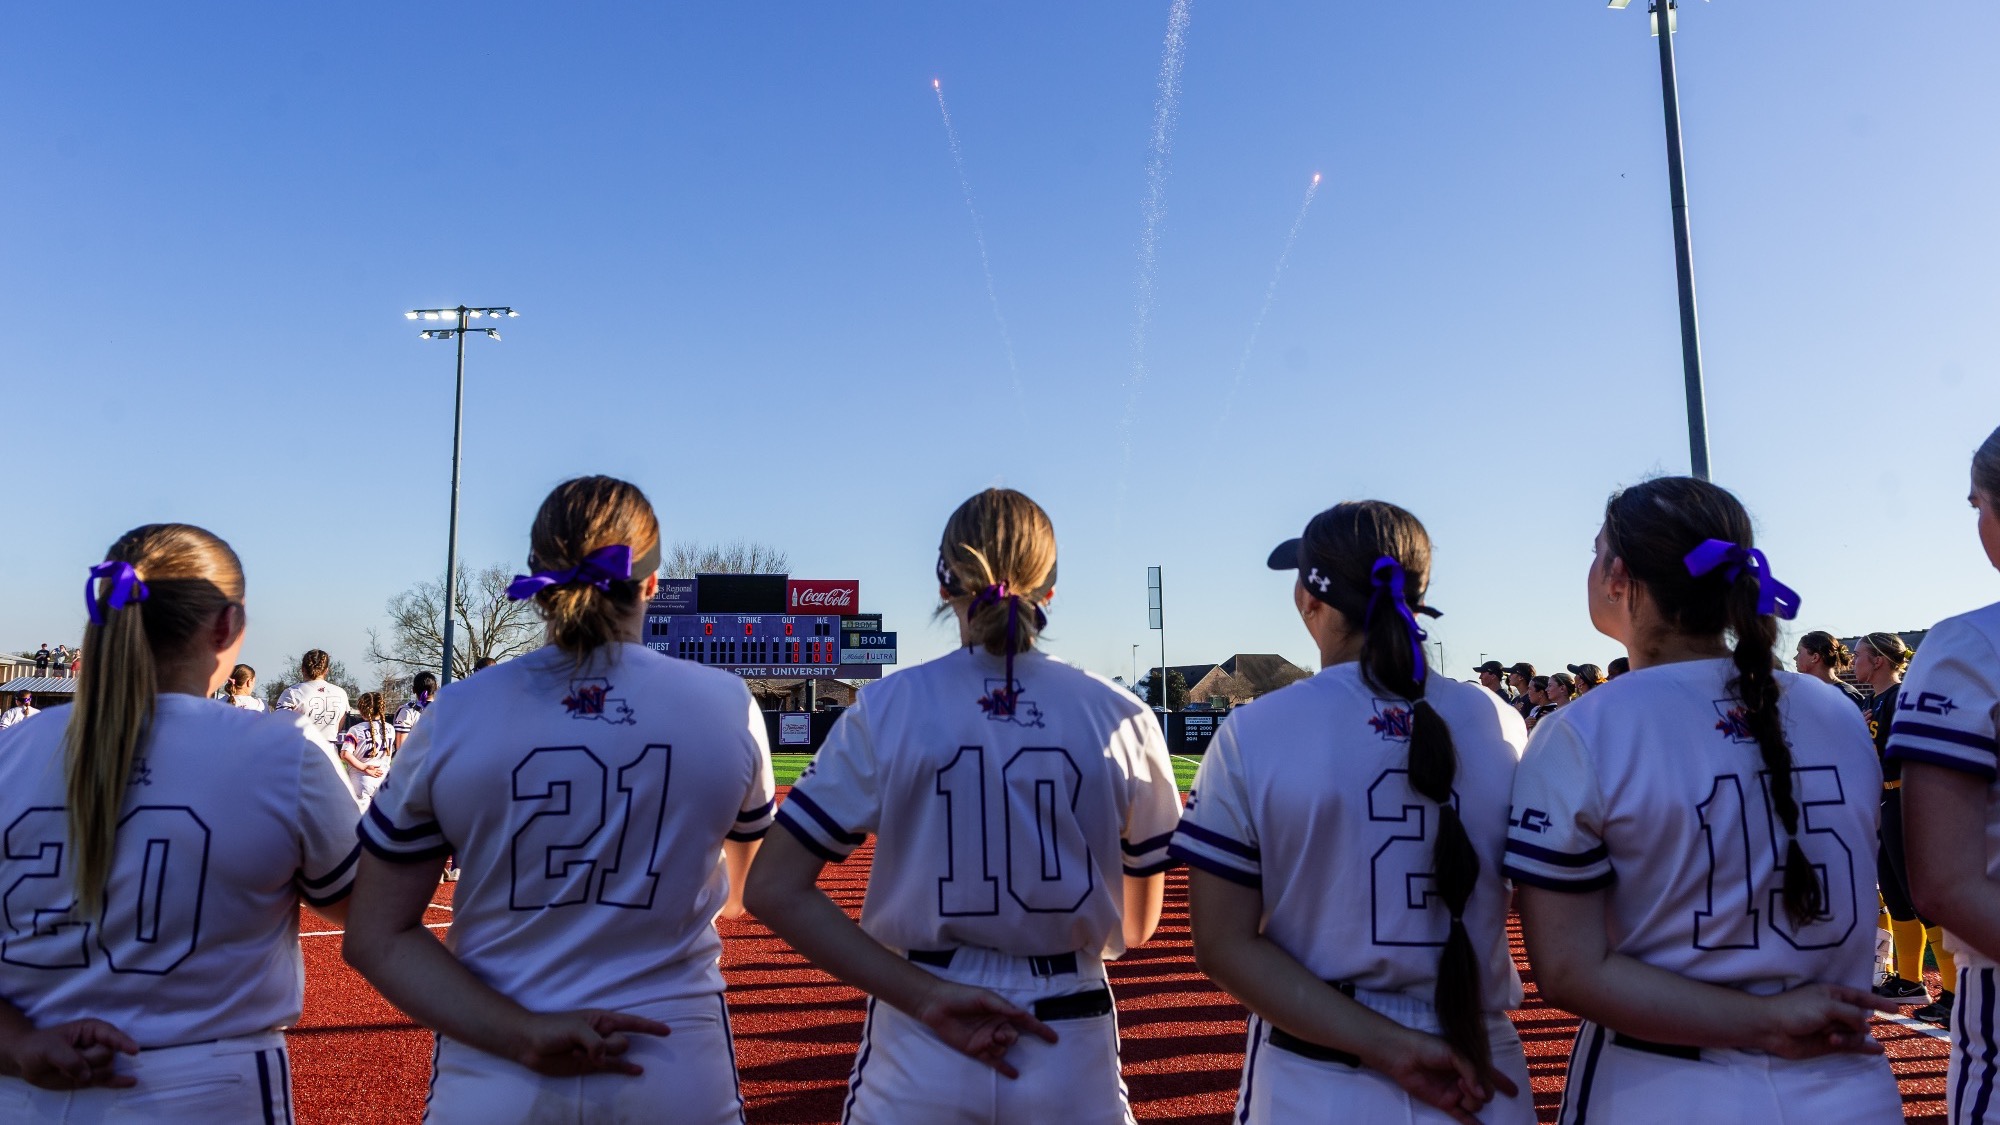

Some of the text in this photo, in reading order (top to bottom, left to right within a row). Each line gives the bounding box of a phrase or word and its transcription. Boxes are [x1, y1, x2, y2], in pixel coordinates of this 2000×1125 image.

[666, 584, 693, 594] Regional
[661, 592, 681, 600] Center
[800, 588, 853, 606] Coca-Cola
[700, 616, 718, 624] BALL
[737, 616, 762, 624] STRIKE
[781, 616, 796, 624] OUT
[816, 616, 828, 624] H/E
[705, 623, 713, 635] 0
[745, 623, 753, 635] 0
[785, 623, 793, 635] 0
[860, 636, 887, 645] BOM
[646, 642, 670, 651] GUEST
[793, 642, 832, 652] 0 0 0
[793, 653, 832, 663] 0 0 0
[734, 667, 767, 676] STATE
[772, 667, 837, 676] UNIVERSITY
[1897, 691, 1947, 715] LC
[308, 696, 343, 726] 25
[509, 743, 671, 911] 21
[936, 745, 1094, 917] 10
[1367, 768, 1460, 947] 2
[1692, 765, 1858, 951] 15
[1, 805, 211, 976] 20
